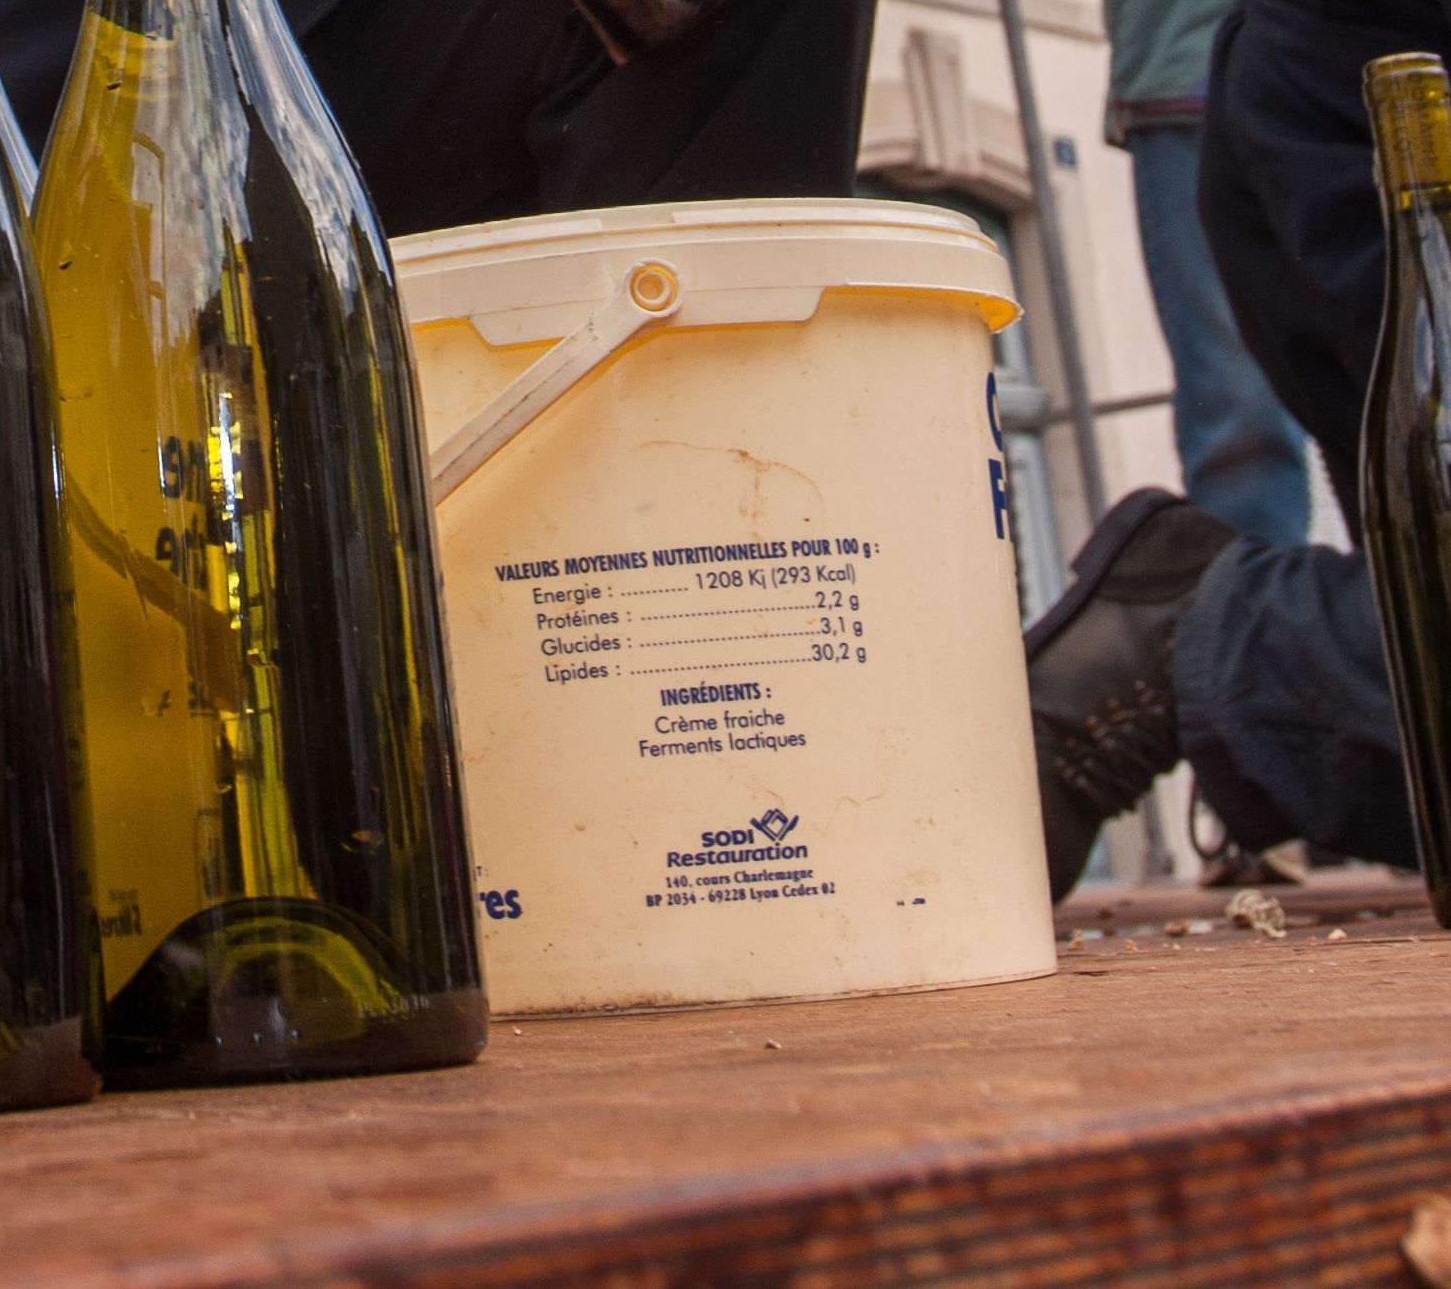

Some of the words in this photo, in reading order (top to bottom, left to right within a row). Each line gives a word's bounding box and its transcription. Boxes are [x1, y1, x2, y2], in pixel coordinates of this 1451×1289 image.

[495, 559, 560, 582] VALEURS
[565, 552, 648, 575] MOYENNES
[652, 541, 788, 567] NUTRITIONNELLES
[791, 539, 832, 558] POUR
[836, 538, 859, 555] 100
[863, 542, 871, 559] g
[533, 583, 602, 605] Energie
[695, 570, 744, 590] 1208
[771, 566, 811, 589] (293
[816, 563, 856, 585] Kcal)
[537, 609, 619, 630] Protéines
[849, 595, 860, 611] g
[541, 634, 621, 656] Glucides
[853, 621, 863, 637] g
[545, 661, 609, 685] Lipides
[856, 647, 867, 663] g
[660, 681, 761, 707] INGRÉDIENTS
[654, 715, 718, 734] Crème
[724, 708, 785, 729] fraiche
[638, 737, 723, 757] Ferments
[728, 731, 807, 752] lactiques
[701, 828, 755, 848] SODI
[666, 842, 808, 868] Restauration
[696, 875, 730, 887] cours
[733, 869, 814, 883] Charlemagne
[645, 894, 662, 907] BP
[708, 888, 747, 903] 69228
[749, 888, 779, 903] Lyon
[782, 884, 818, 898] Cedex
[821, 882, 836, 894] 02
